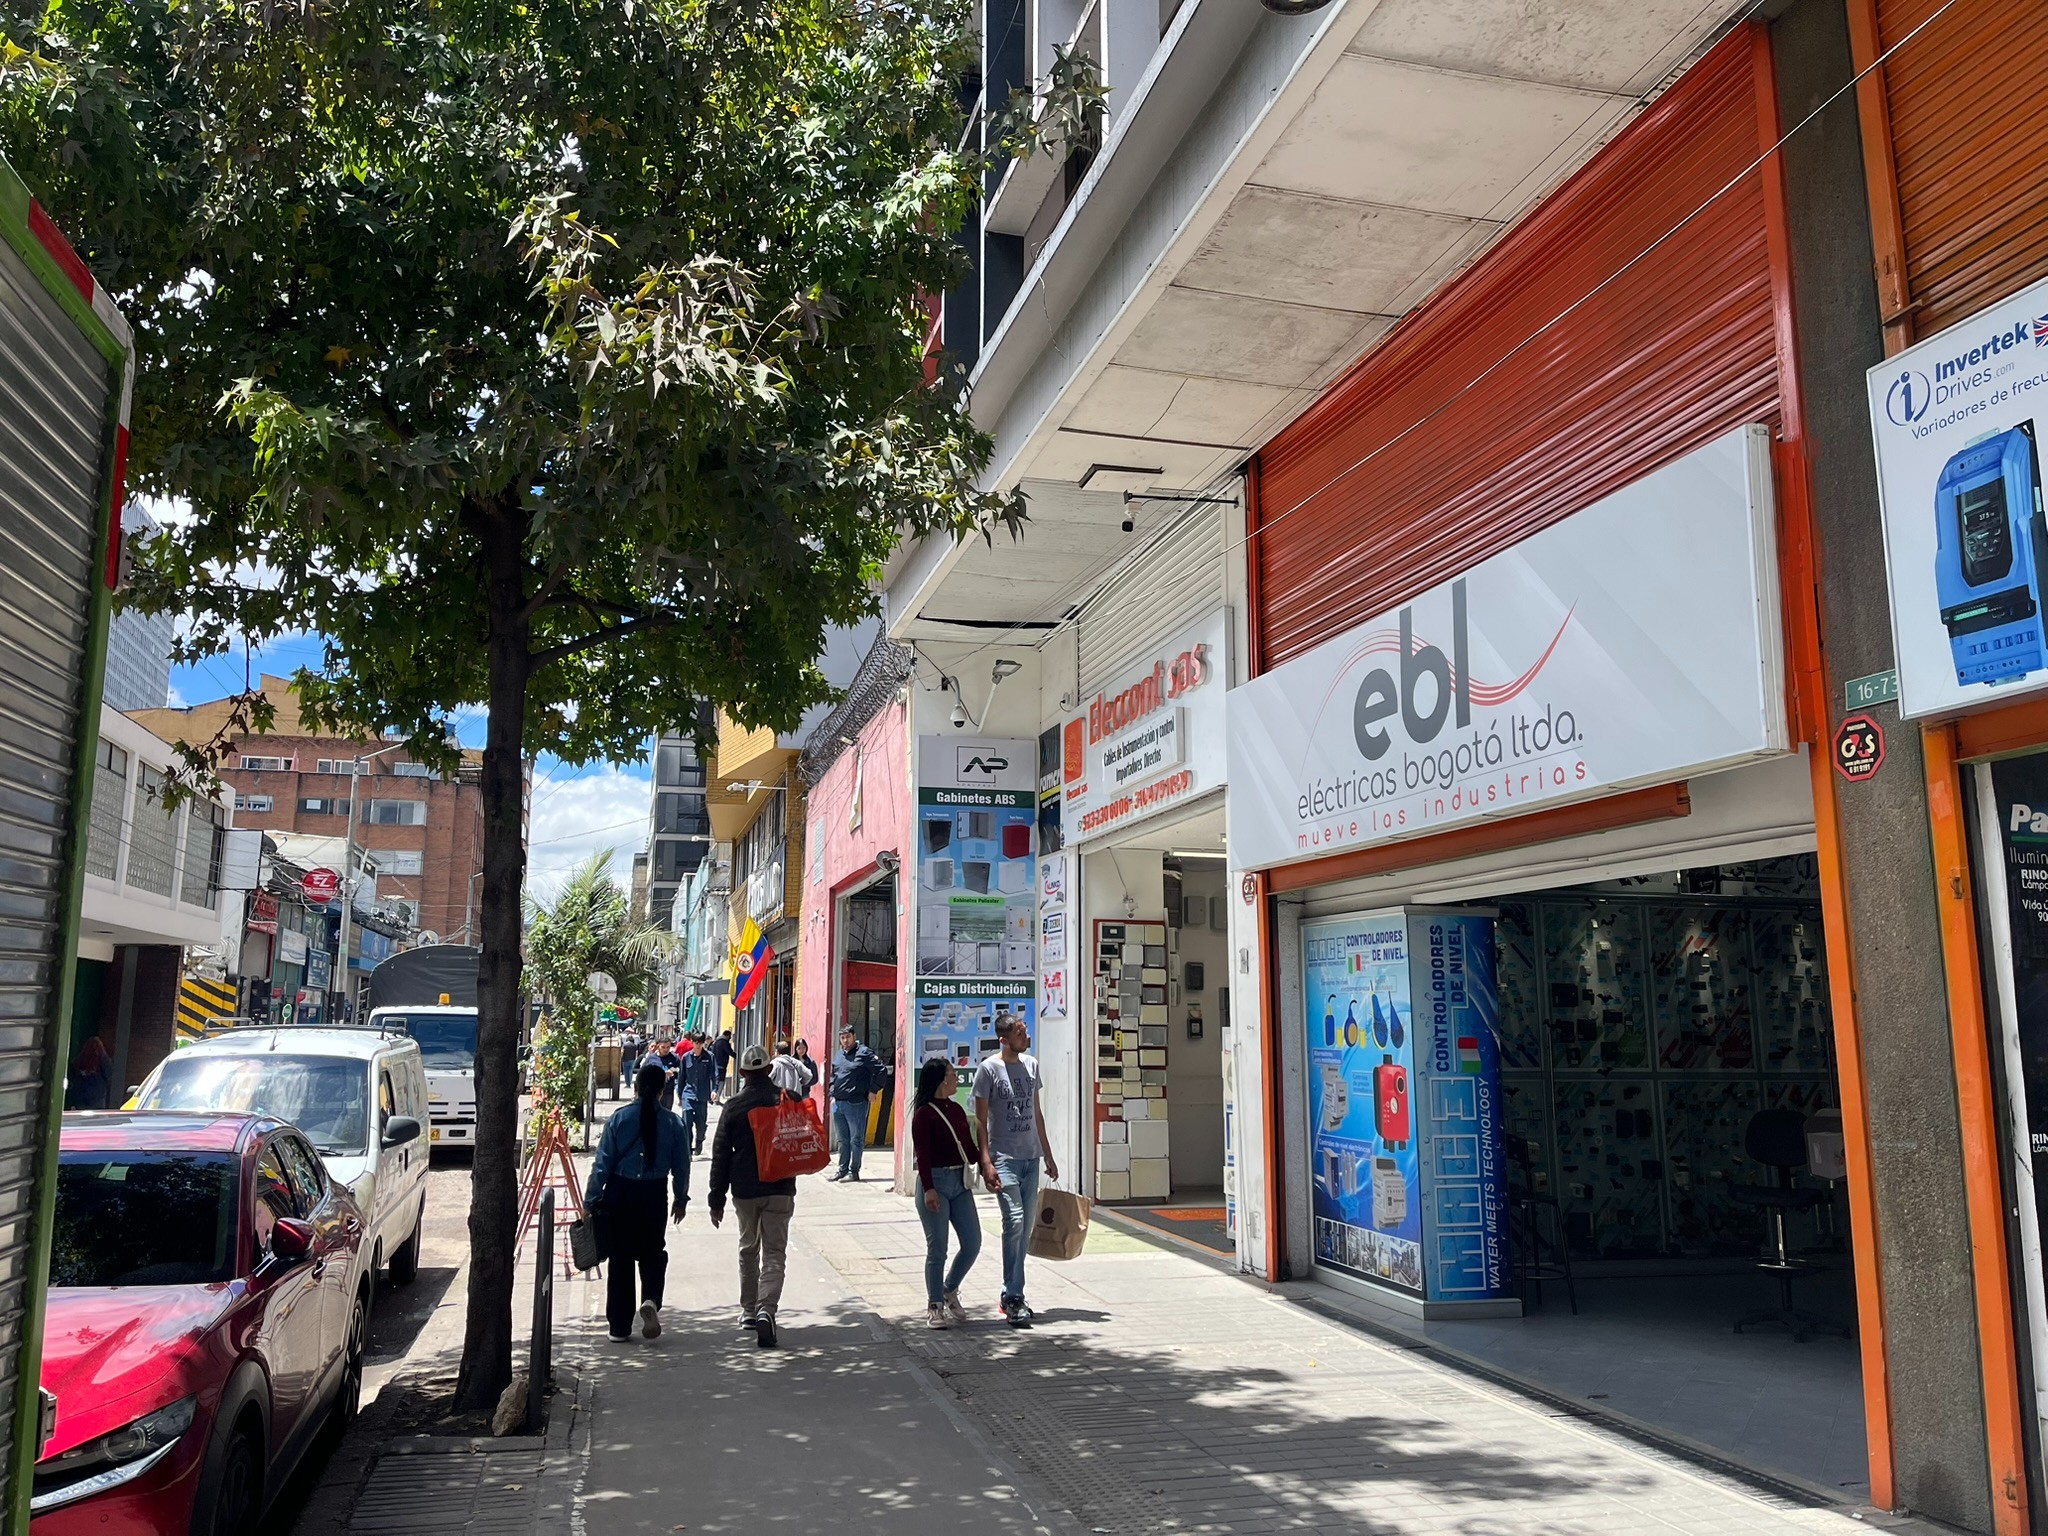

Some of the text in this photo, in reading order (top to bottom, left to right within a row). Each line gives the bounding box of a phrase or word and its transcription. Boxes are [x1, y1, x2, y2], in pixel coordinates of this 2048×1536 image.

[1935, 322, 2029, 383] Invertek
[1936, 368, 1992, 405] Drives
[1912, 400, 1987, 440] Variadores
[1990, 390, 2008, 405] de
[1167, 643, 1204, 699] sas
[1354, 577, 1471, 761] ebl
[1857, 675, 1897, 701] 16-73
[963, 756, 1009, 773] AP
[1144, 748, 1162, 768] Directos
[1298, 703, 1583, 819] eléctricas bogotá ltda.
[936, 791, 1016, 805] Gabinetes ABS
[1298, 760, 1586, 849] mueve las industrias
[2022, 898, 2042, 910] Vida
[1346, 929, 1403, 947] CONTROLADORES
[1372, 947, 1404, 961] DE NIVEL
[1448, 924, 1464, 1003] DE NIVEL
[924, 983, 1027, 996] Cajas Distribución
[1430, 924, 1449, 1073] CONTROLADORES
[1479, 1077, 1500, 1289] WATER MEETS TECHNOLOGY
